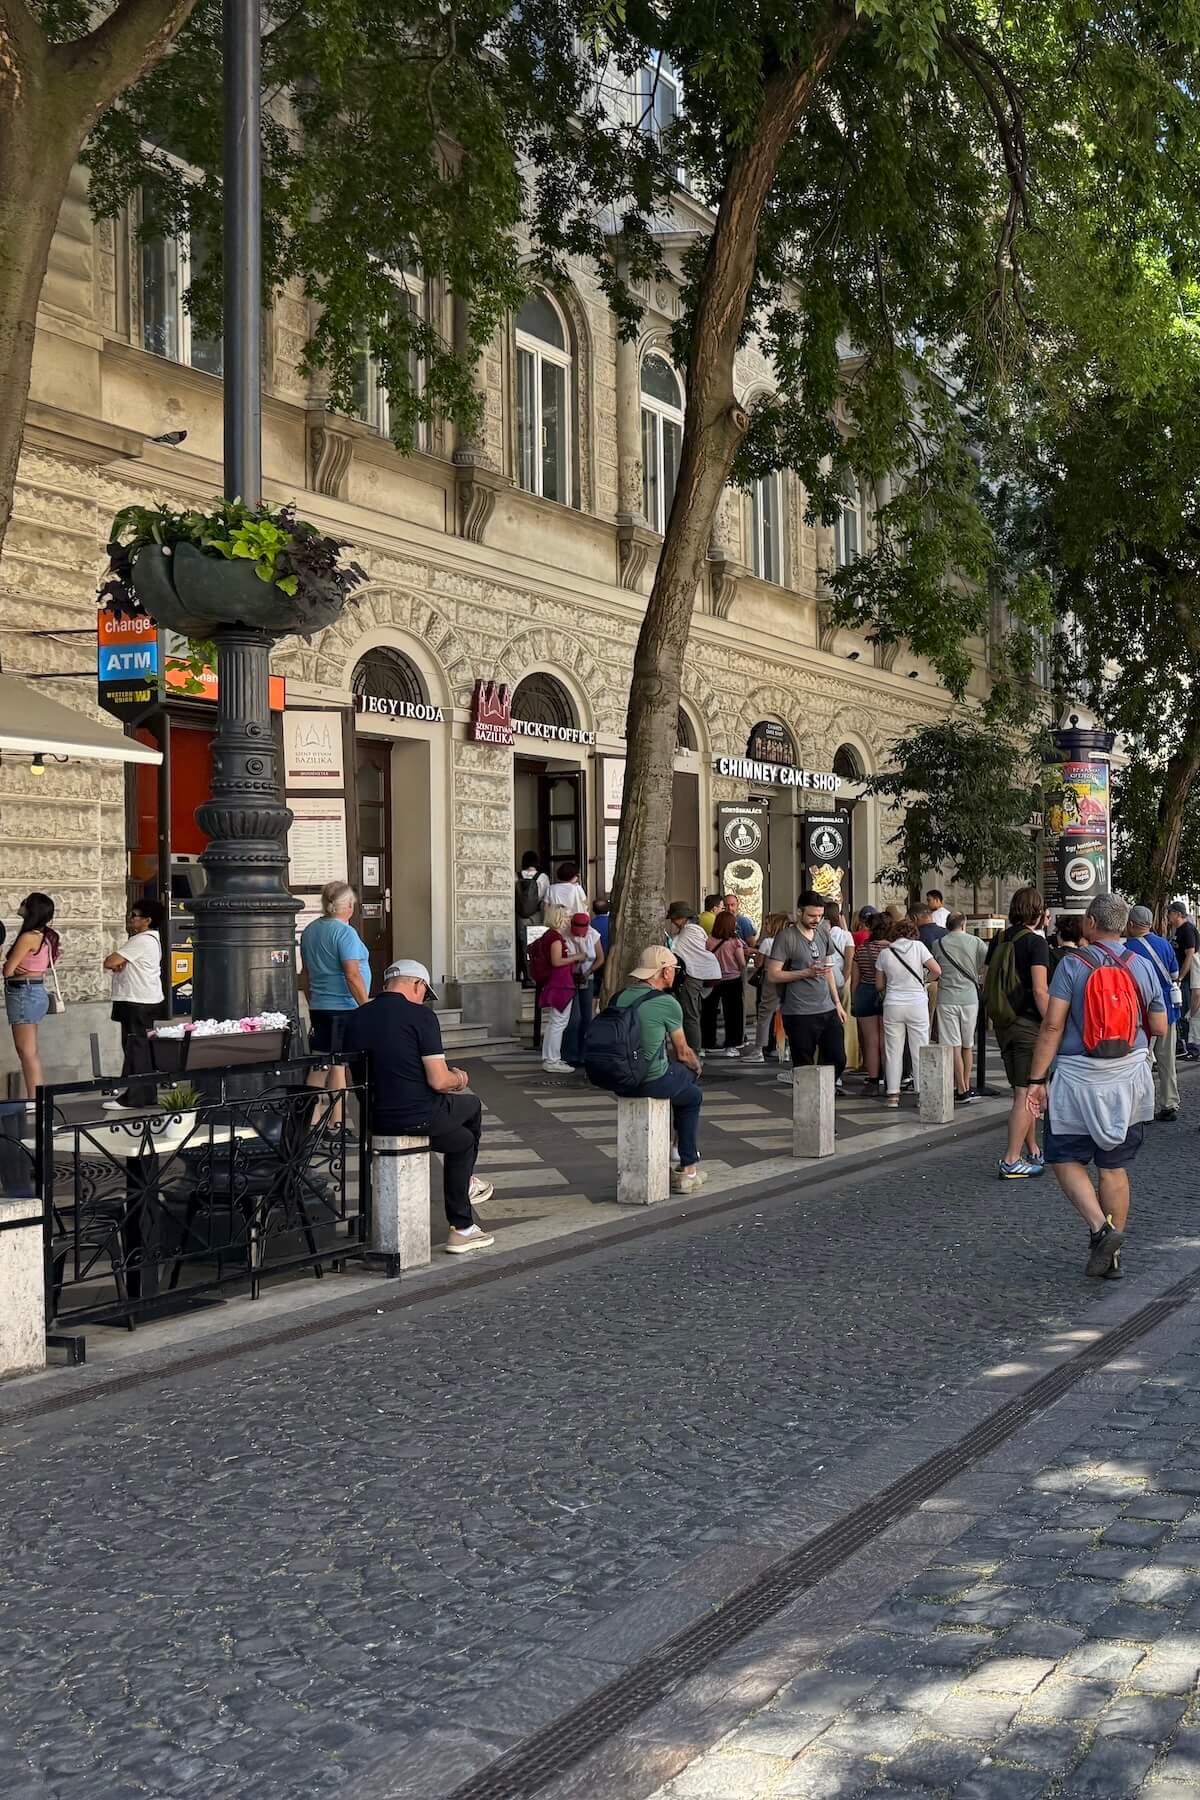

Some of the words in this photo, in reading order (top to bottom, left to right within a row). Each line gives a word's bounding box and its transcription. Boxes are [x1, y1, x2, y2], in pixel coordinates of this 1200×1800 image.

[105, 618, 151, 633] change
[107, 652, 151, 671] ATM
[362, 695, 445, 722] JEGYIRODA
[475, 730, 514, 745] BAZILIKA
[517, 720, 558, 739] TICKET
[558, 727, 595, 745] OFFICE
[720, 758, 777, 782] CHIMNEY
[780, 767, 810, 788] CAKE
[812, 773, 842, 793] SHOP
